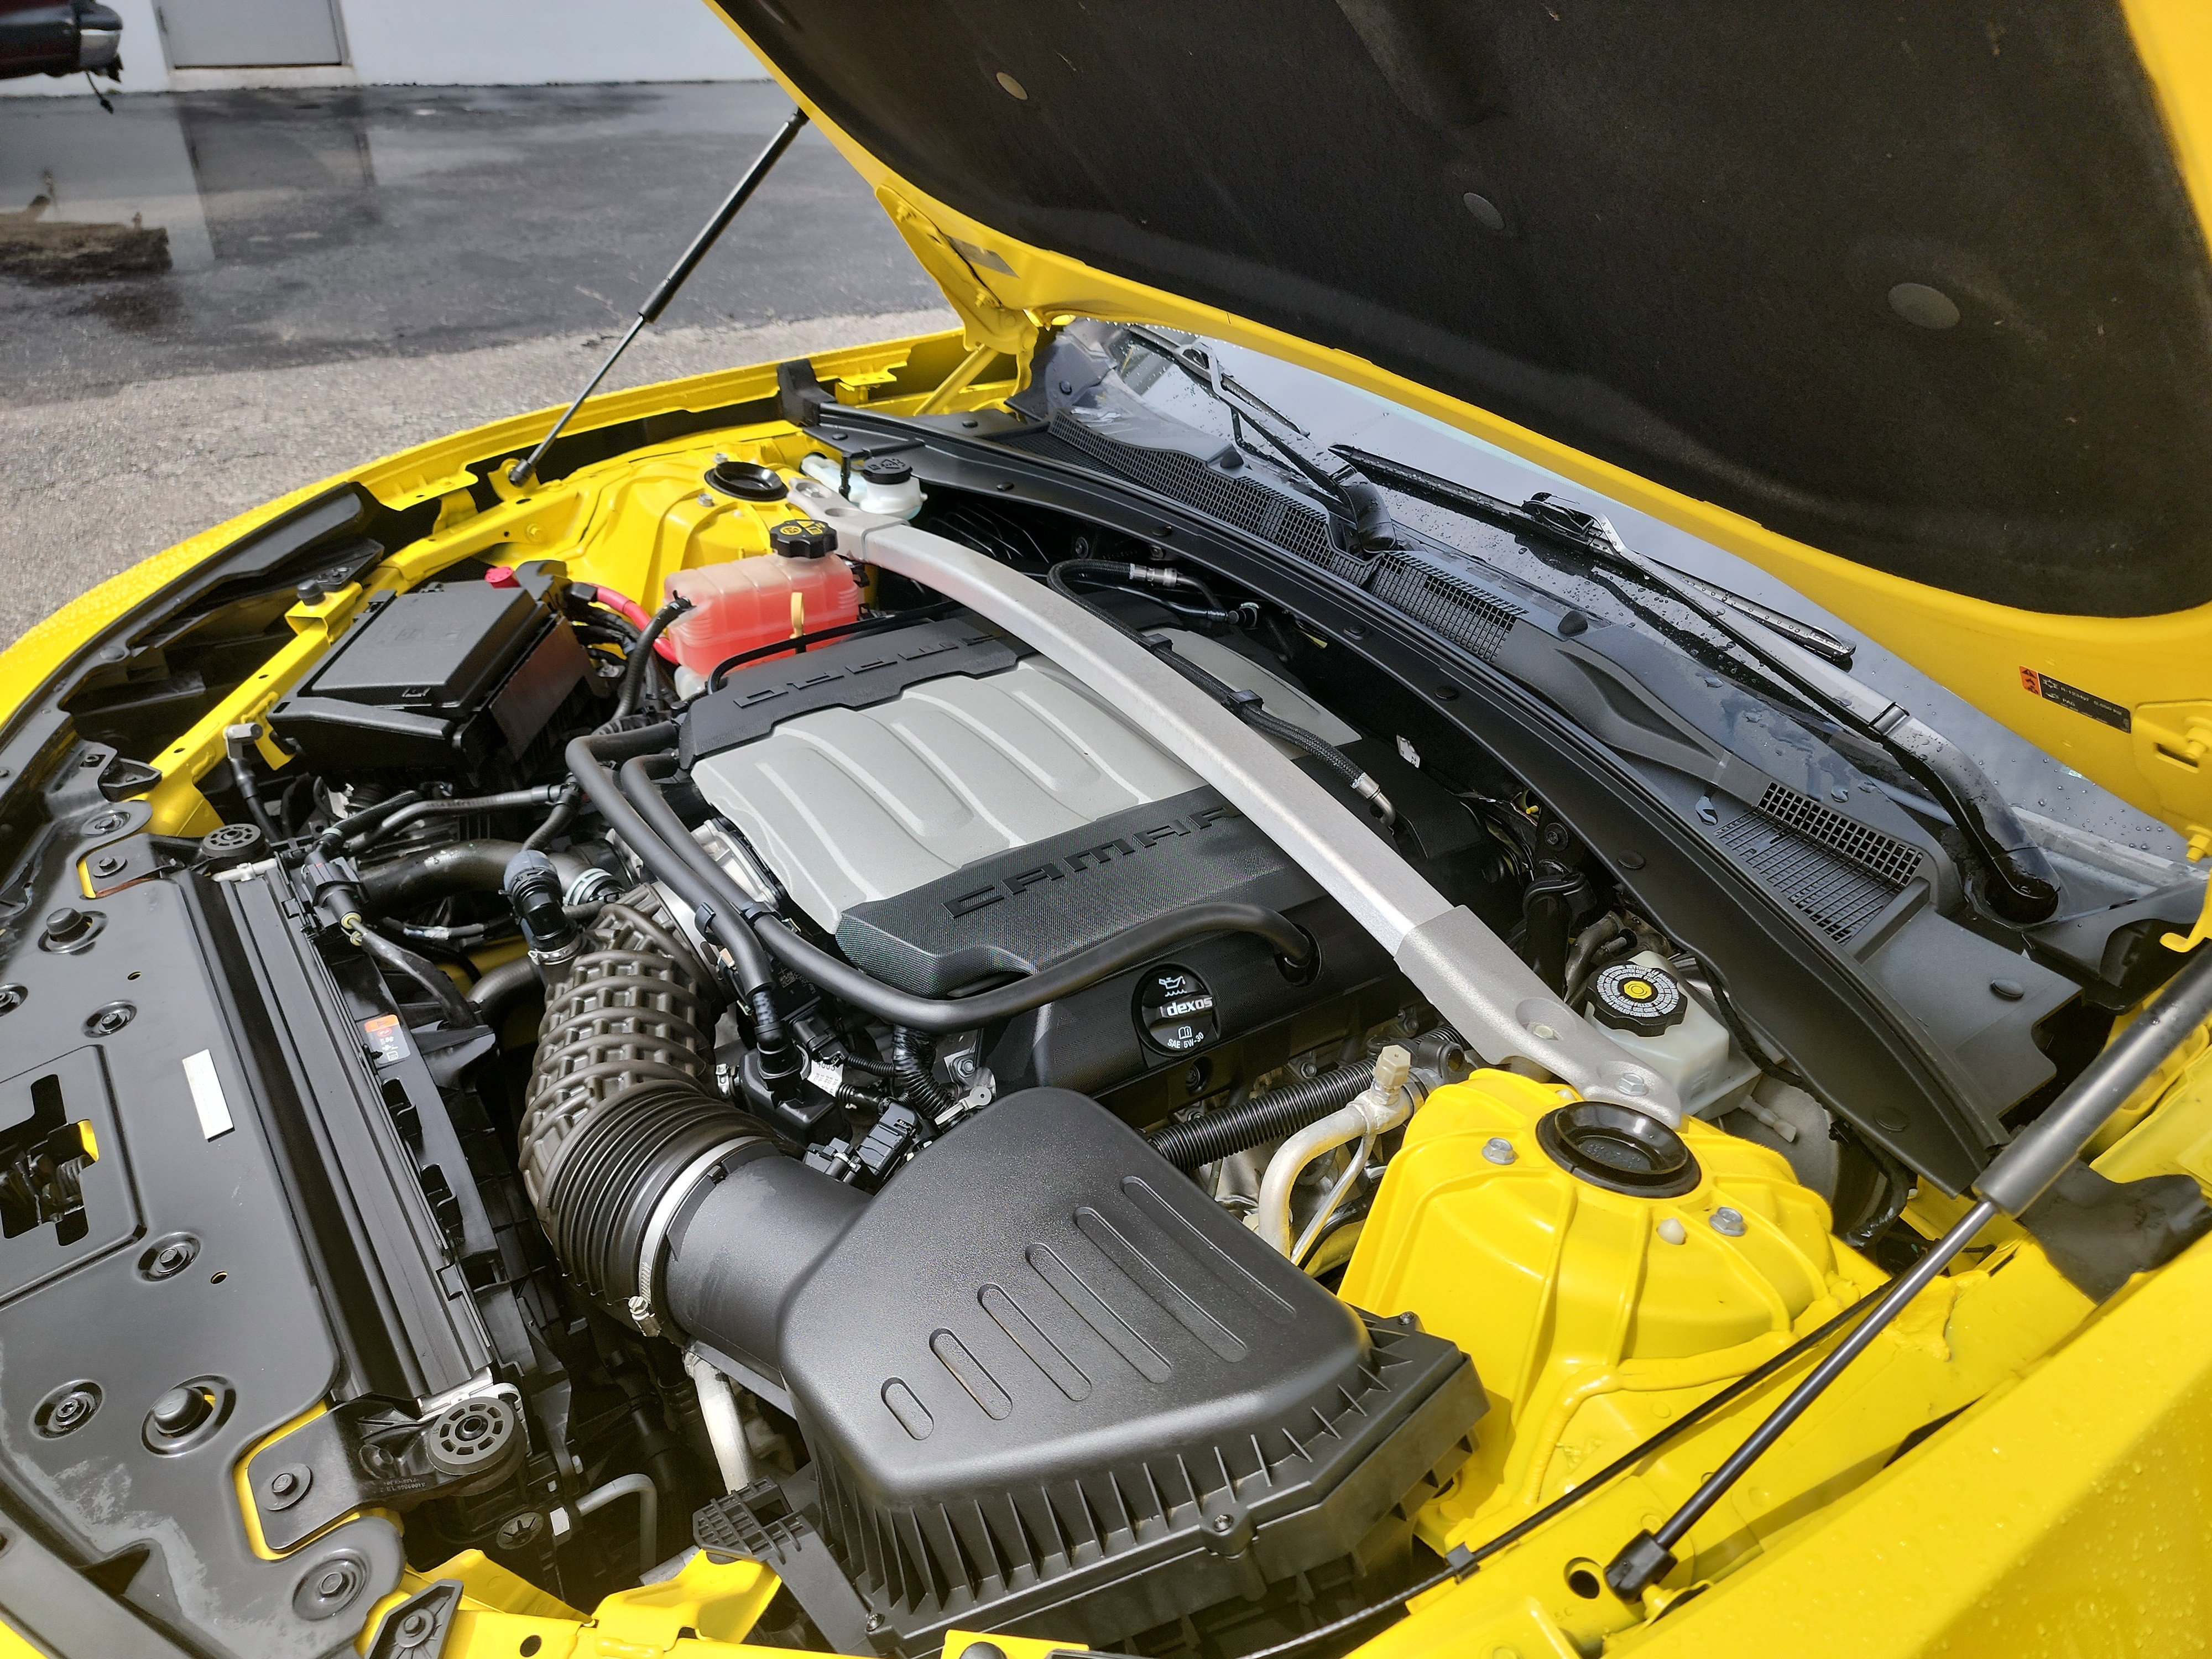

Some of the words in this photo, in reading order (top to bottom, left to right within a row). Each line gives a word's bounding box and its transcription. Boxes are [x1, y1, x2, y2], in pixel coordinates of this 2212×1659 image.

[733, 631, 1002, 709] AMARO
[941, 804, 1242, 920] CAMAR
[1166, 997, 1213, 1016] dexos
[1167, 1039, 1181, 1048] SAE
[1183, 1032, 1204, 1048] 5W-30
